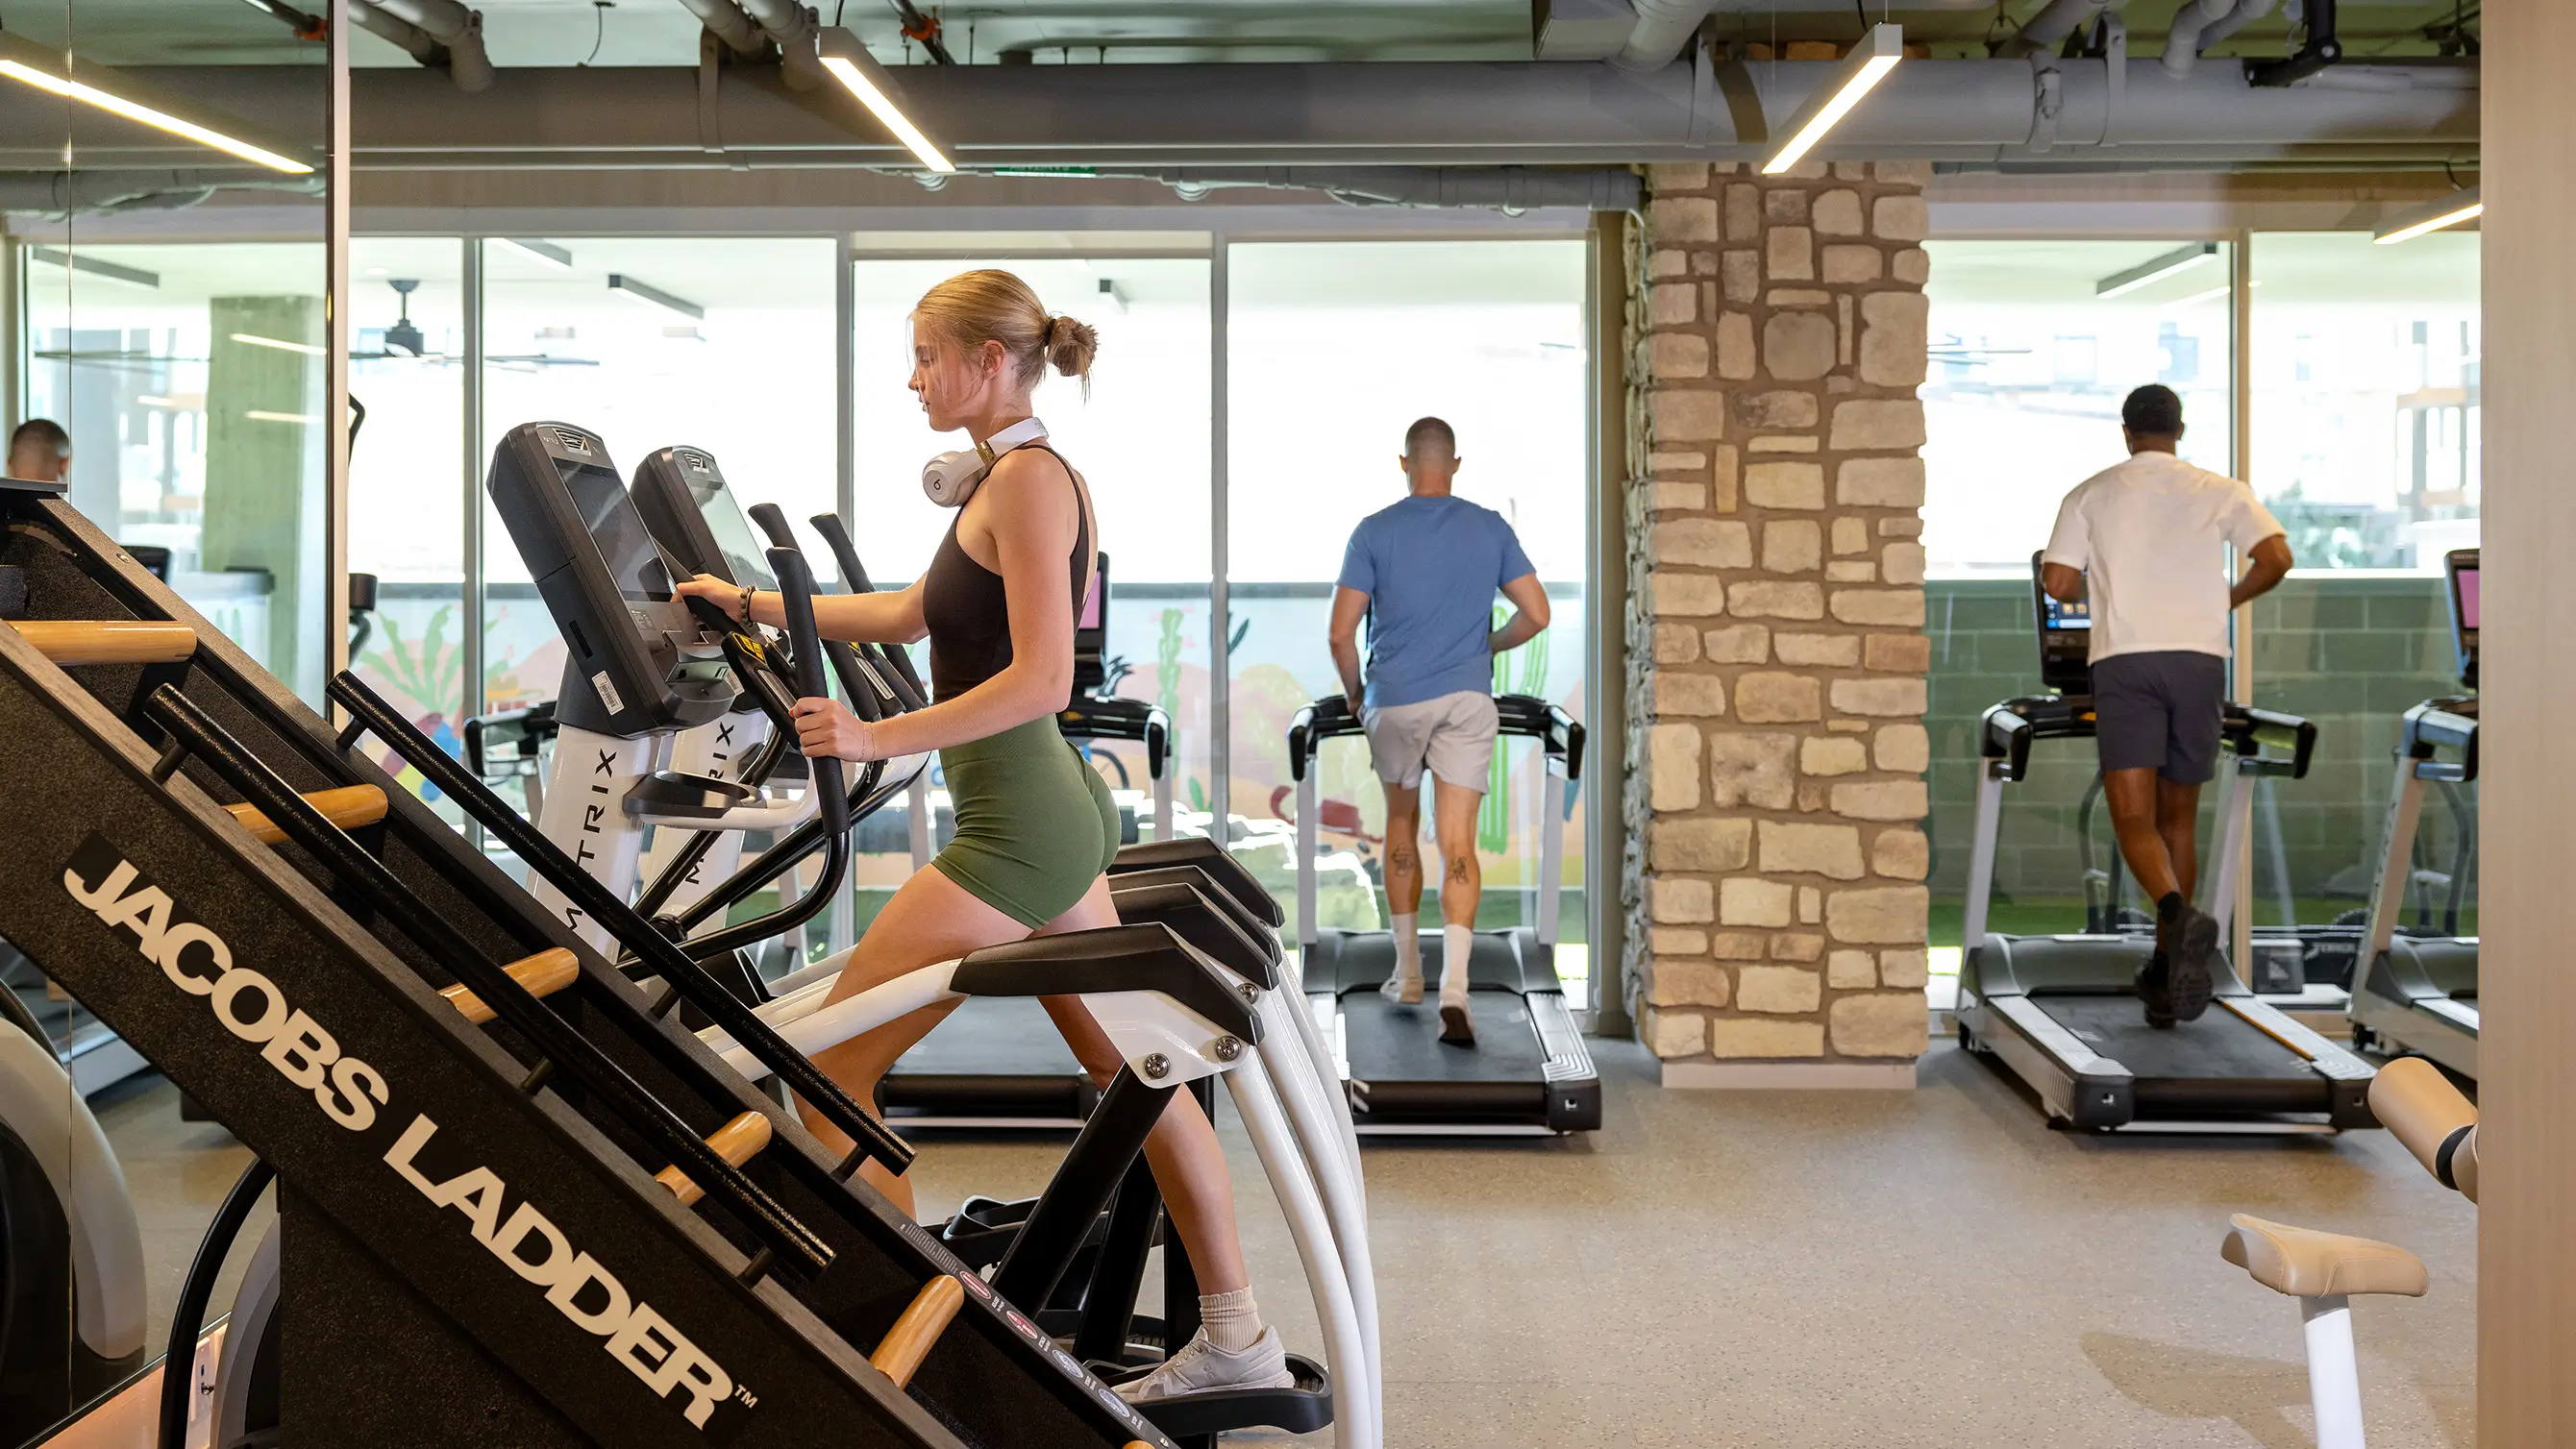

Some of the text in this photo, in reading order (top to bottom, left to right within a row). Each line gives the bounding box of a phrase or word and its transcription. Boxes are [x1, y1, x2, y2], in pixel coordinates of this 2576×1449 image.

[566, 748, 617, 931] MTRIX
[63, 858, 389, 1131] JACOBS
[383, 1113, 733, 1431] LADDER
